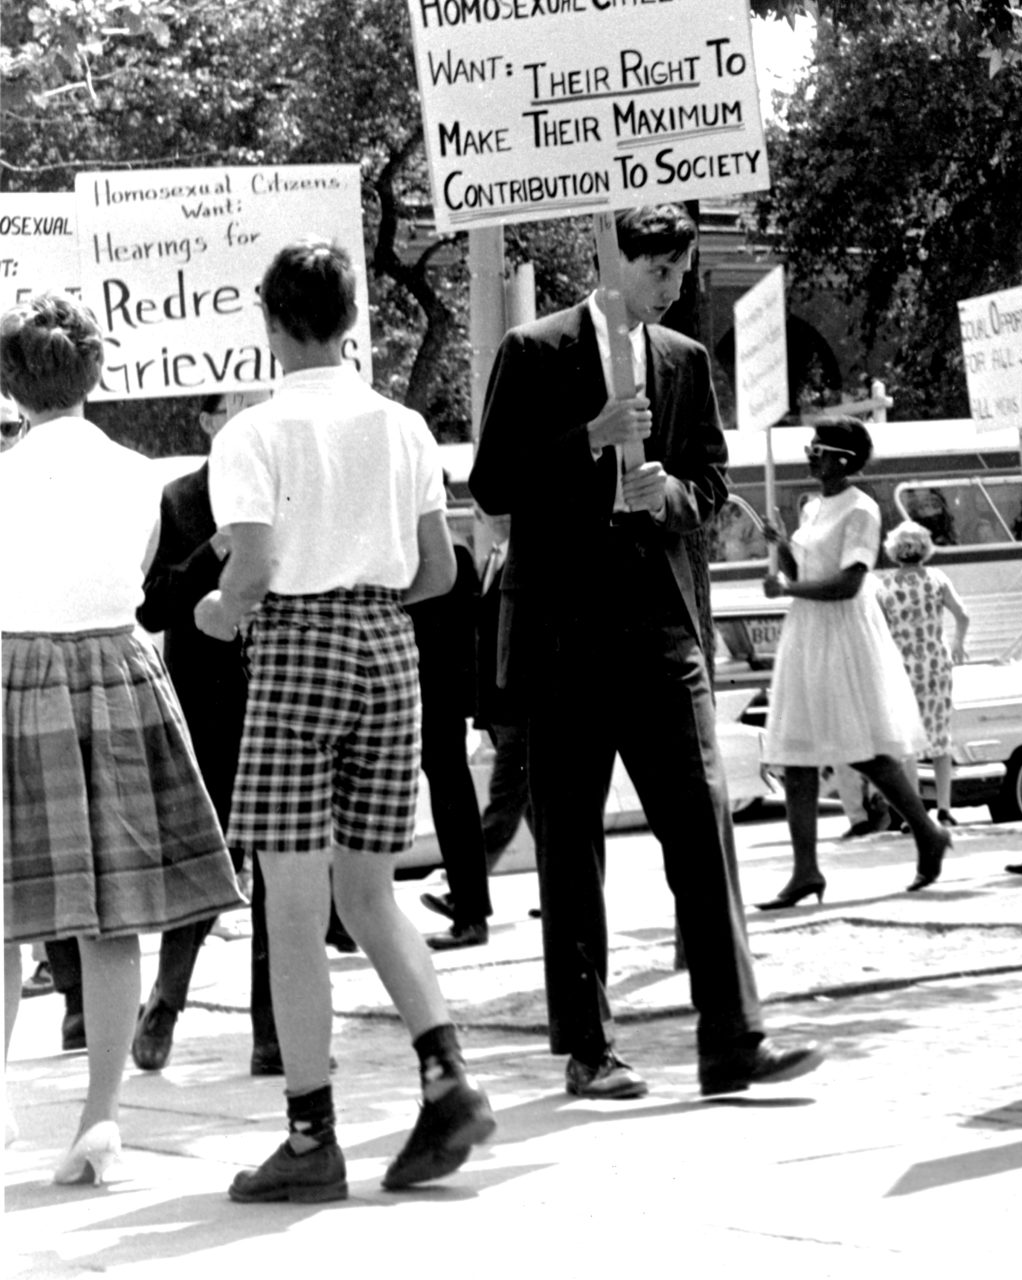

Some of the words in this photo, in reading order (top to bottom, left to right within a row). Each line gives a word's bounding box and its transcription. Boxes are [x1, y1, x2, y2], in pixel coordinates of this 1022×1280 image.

[428, 49, 513, 87] WANT:
[523, 61, 609, 100] THEIR
[620, 49, 700, 90] RIGHT
[706, 37, 746, 78] TO
[438, 120, 512, 157] MAKE
[522, 109, 602, 148] THEIR
[612, 100, 743, 137] MAXIMUM
[94, 173, 232, 208] Homosexual
[251, 172, 341, 196] Citizens
[443, 170, 610, 211] CONTRIBUTION
[614, 154, 648, 189] TO
[655, 148, 761, 185] SOCIETY
[181, 199, 243, 219] Want:
[93, 232, 208, 264] Hearings
[226, 221, 261, 247] for
[102, 269, 264, 332] Redre
